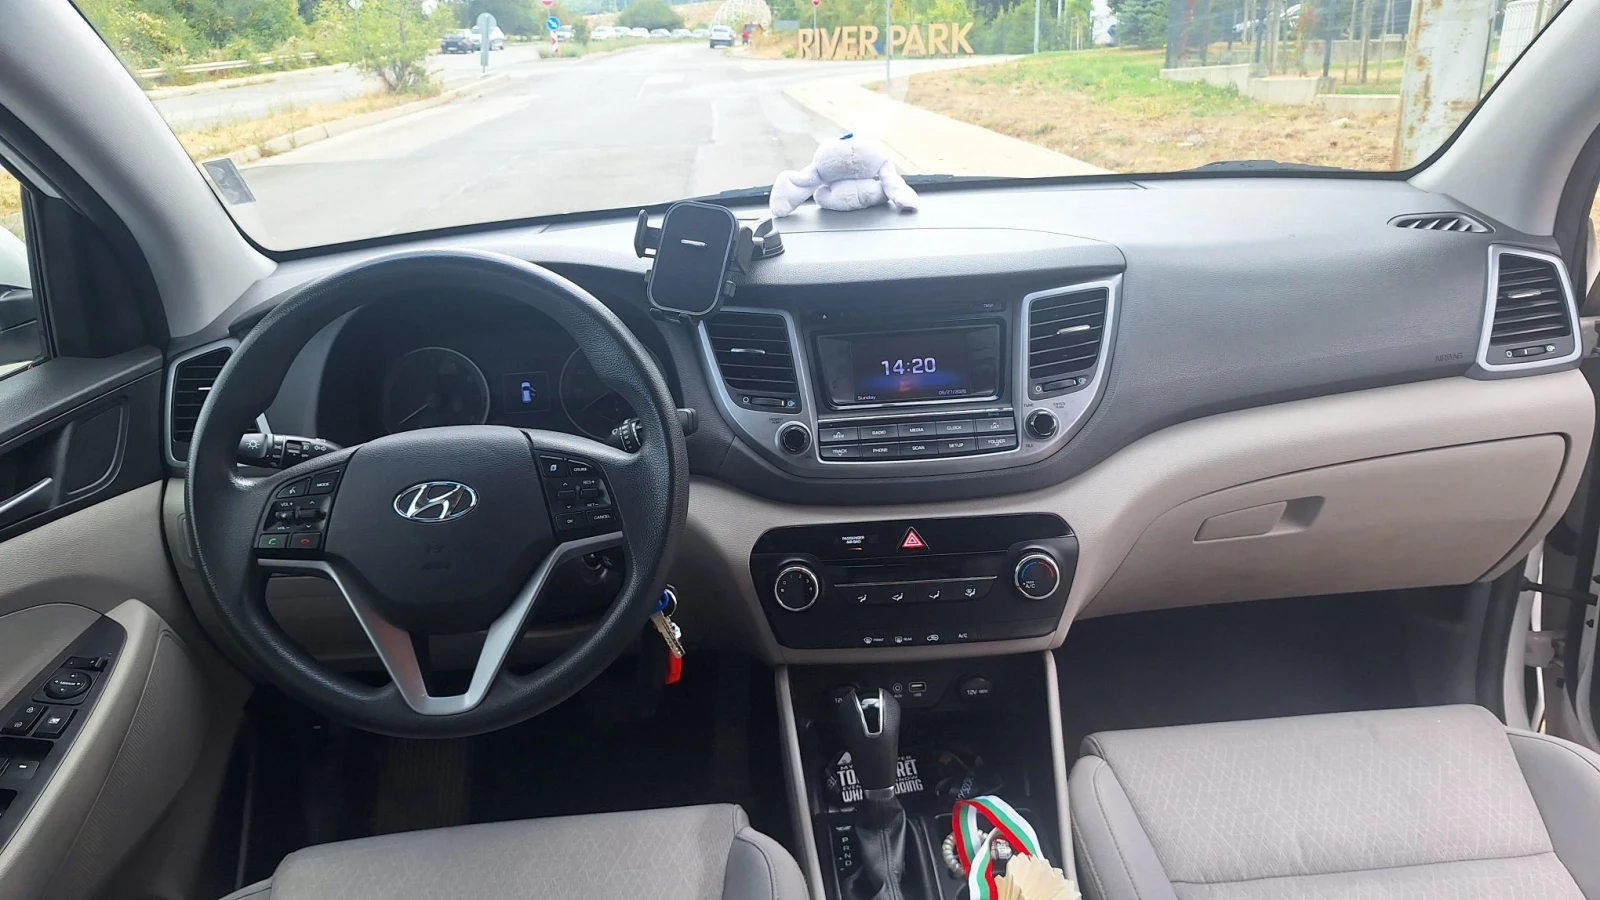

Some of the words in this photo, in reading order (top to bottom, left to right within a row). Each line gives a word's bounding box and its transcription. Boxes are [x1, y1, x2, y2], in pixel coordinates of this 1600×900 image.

[798, 25, 879, 59] RIVER
[889, 22, 974, 56] PARK
[881, 357, 936, 375] 14:20
[837, 769, 860, 786] TO
